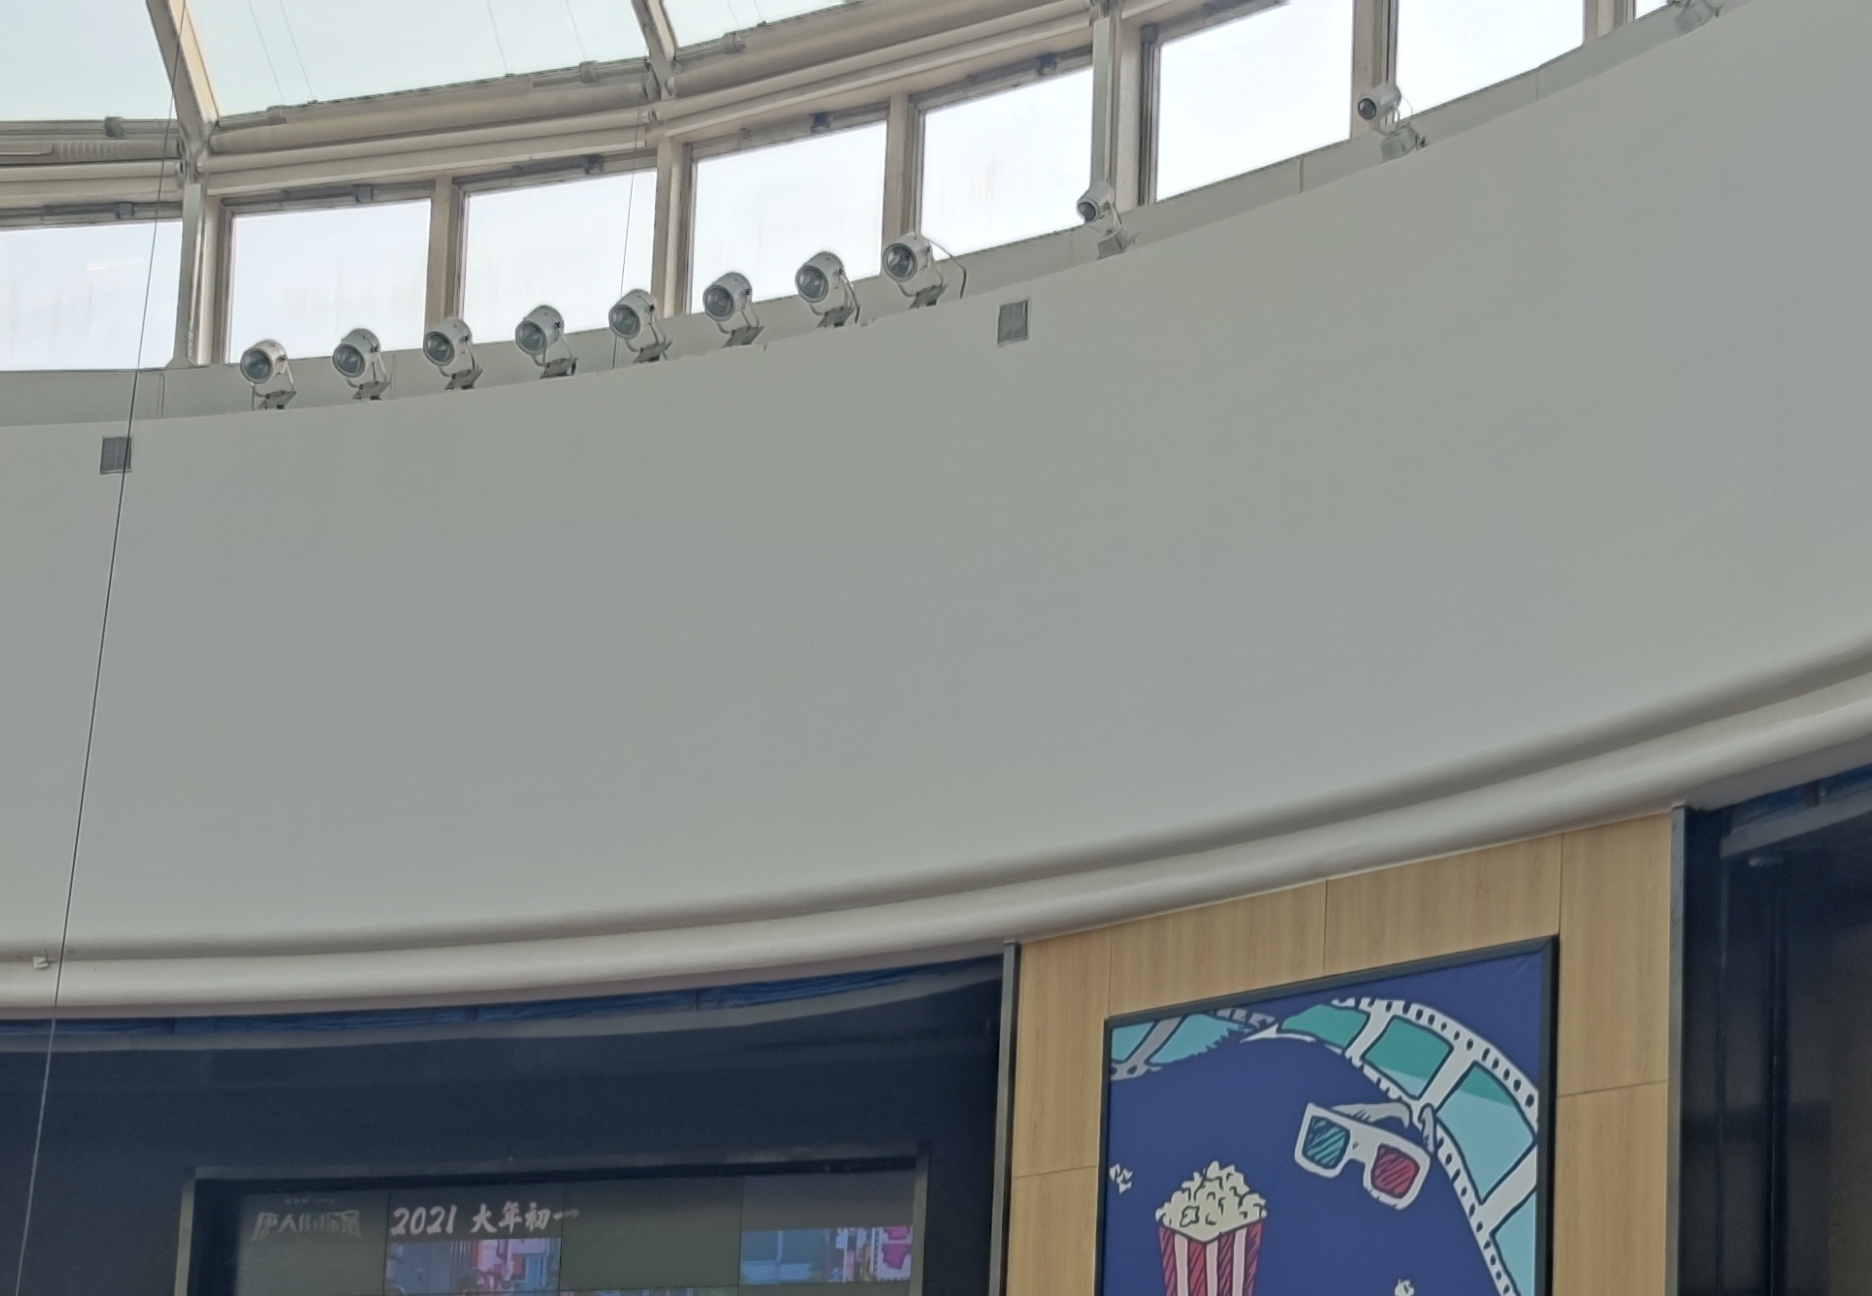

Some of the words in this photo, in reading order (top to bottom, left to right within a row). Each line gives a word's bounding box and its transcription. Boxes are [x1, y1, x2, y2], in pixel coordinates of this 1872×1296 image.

[390, 1204, 458, 1236] 2021
[470, 1201, 579, 1233] 大年初一
